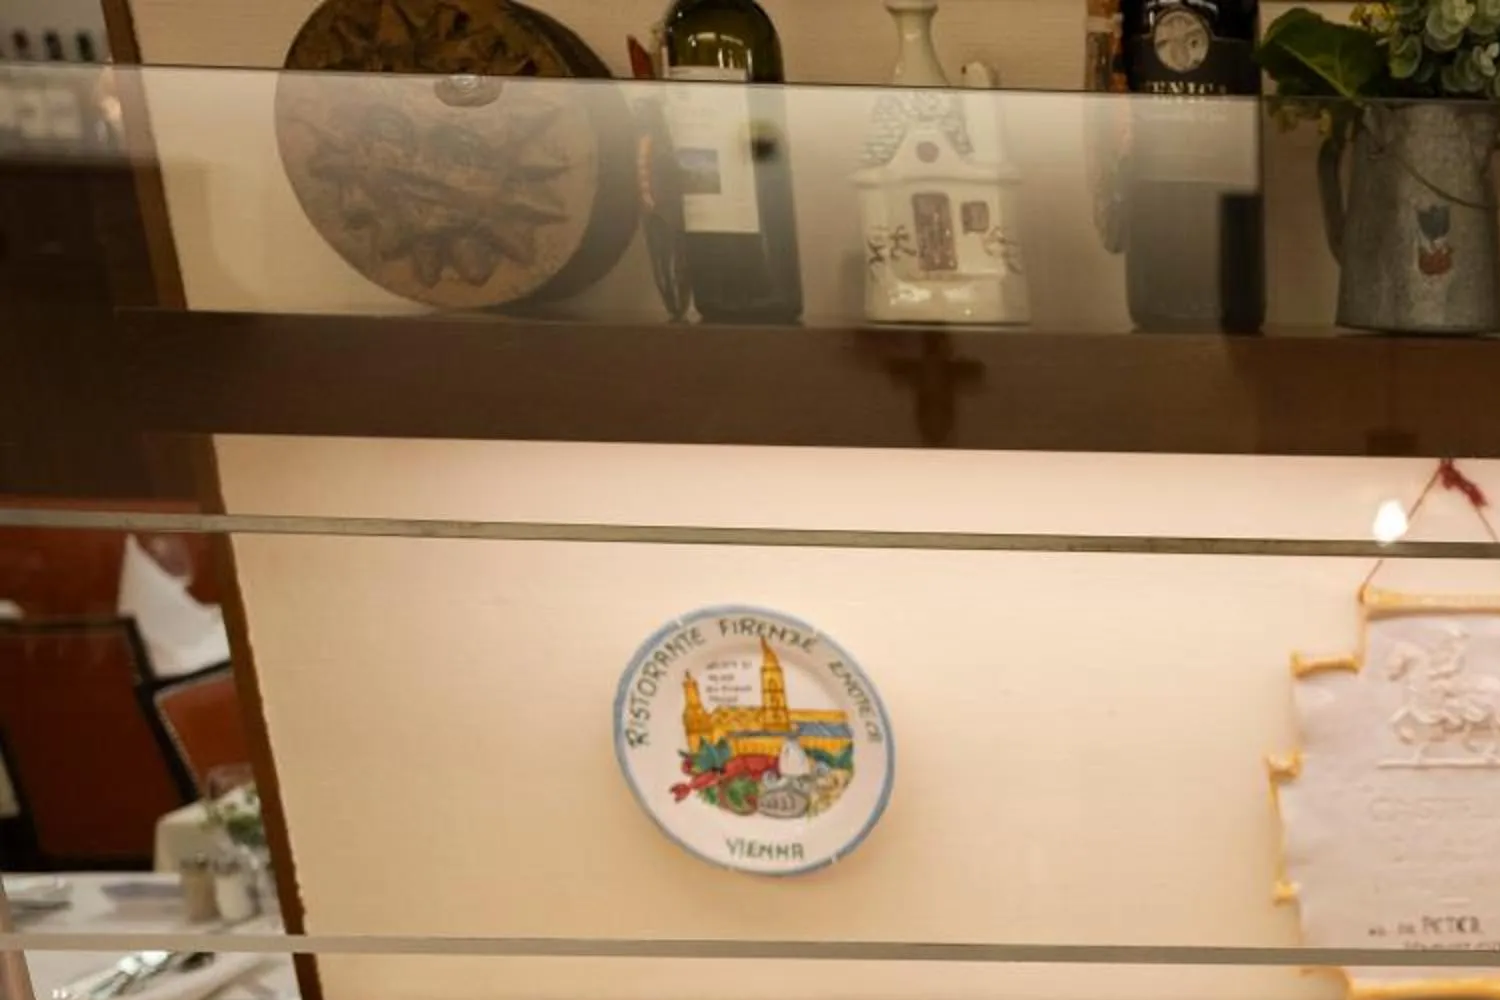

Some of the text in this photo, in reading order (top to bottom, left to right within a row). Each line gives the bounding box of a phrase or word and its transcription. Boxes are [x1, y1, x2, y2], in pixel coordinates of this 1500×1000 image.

[624, 626, 705, 750] RISTORANTE
[719, 617, 817, 654] FIRENZE
[725, 837, 805, 860] VIENNA
